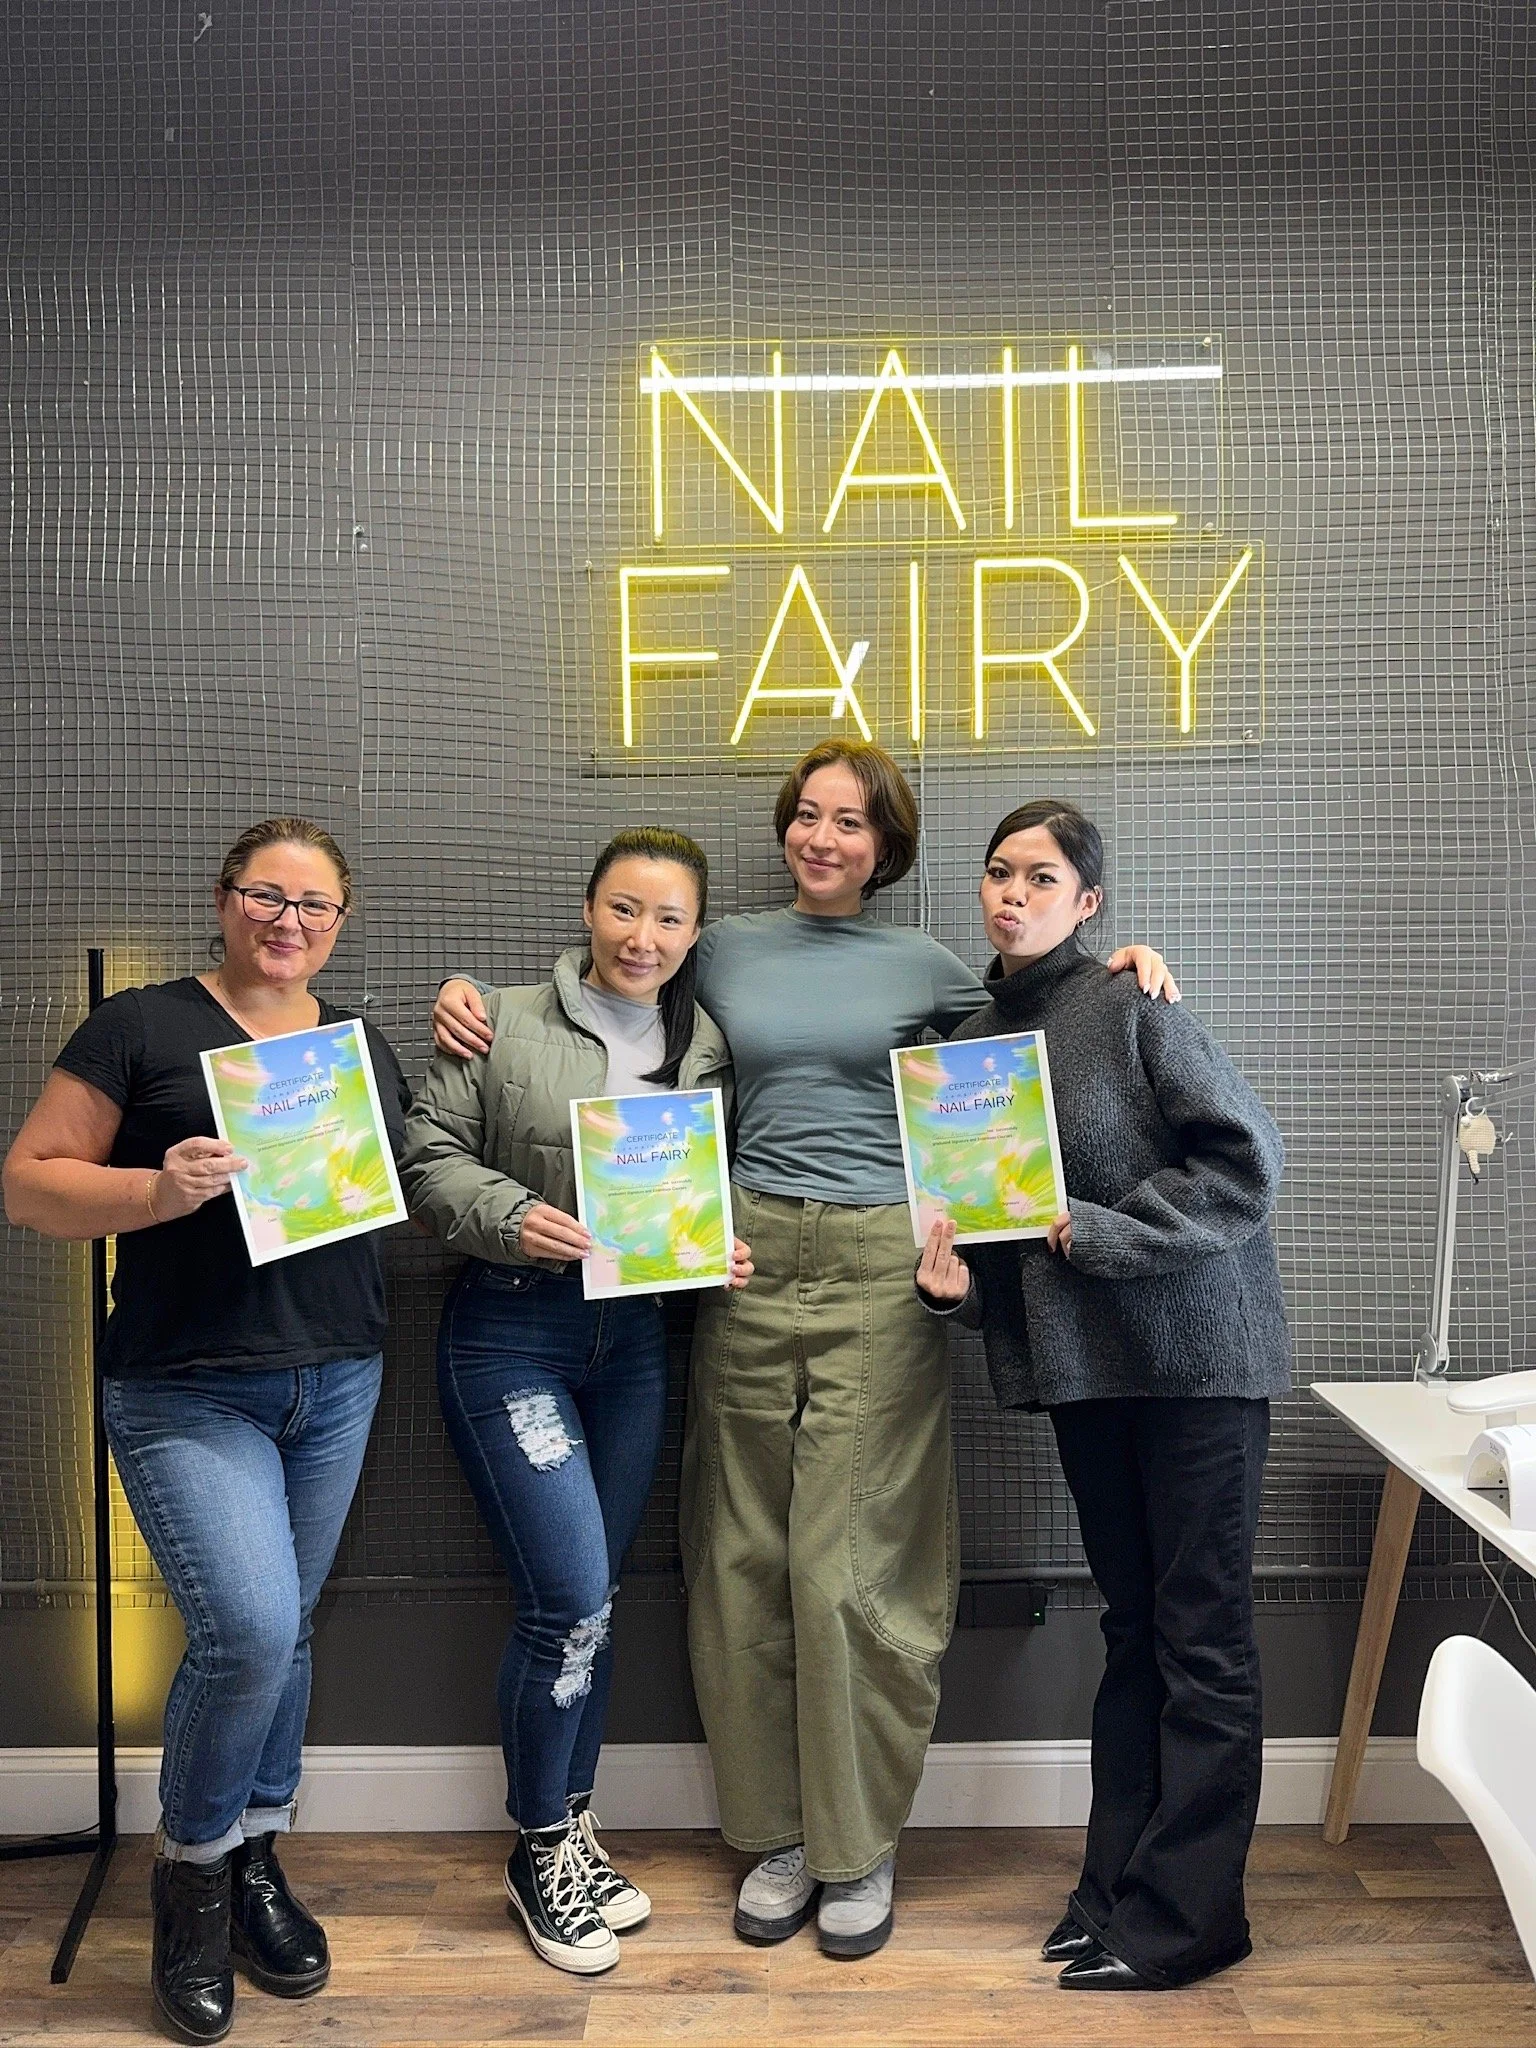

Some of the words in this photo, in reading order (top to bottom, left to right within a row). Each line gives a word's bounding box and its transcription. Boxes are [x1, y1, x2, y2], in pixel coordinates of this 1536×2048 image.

[651, 345, 1178, 537] NAIL
[620, 550, 1253, 746] FAIRY
[269, 1071, 325, 1091] CERTIFICATE
[948, 1078, 1001, 1092] CERTIFICATE
[261, 1099, 295, 1117] NAIL
[297, 1087, 340, 1108] FAIRY
[939, 1101, 971, 1115] NAIL
[974, 1094, 1015, 1111] FAIRY
[626, 1131, 678, 1143] CERTIFICATE
[616, 1152, 648, 1165] NAIL
[651, 1148, 691, 1162] FAIRY
